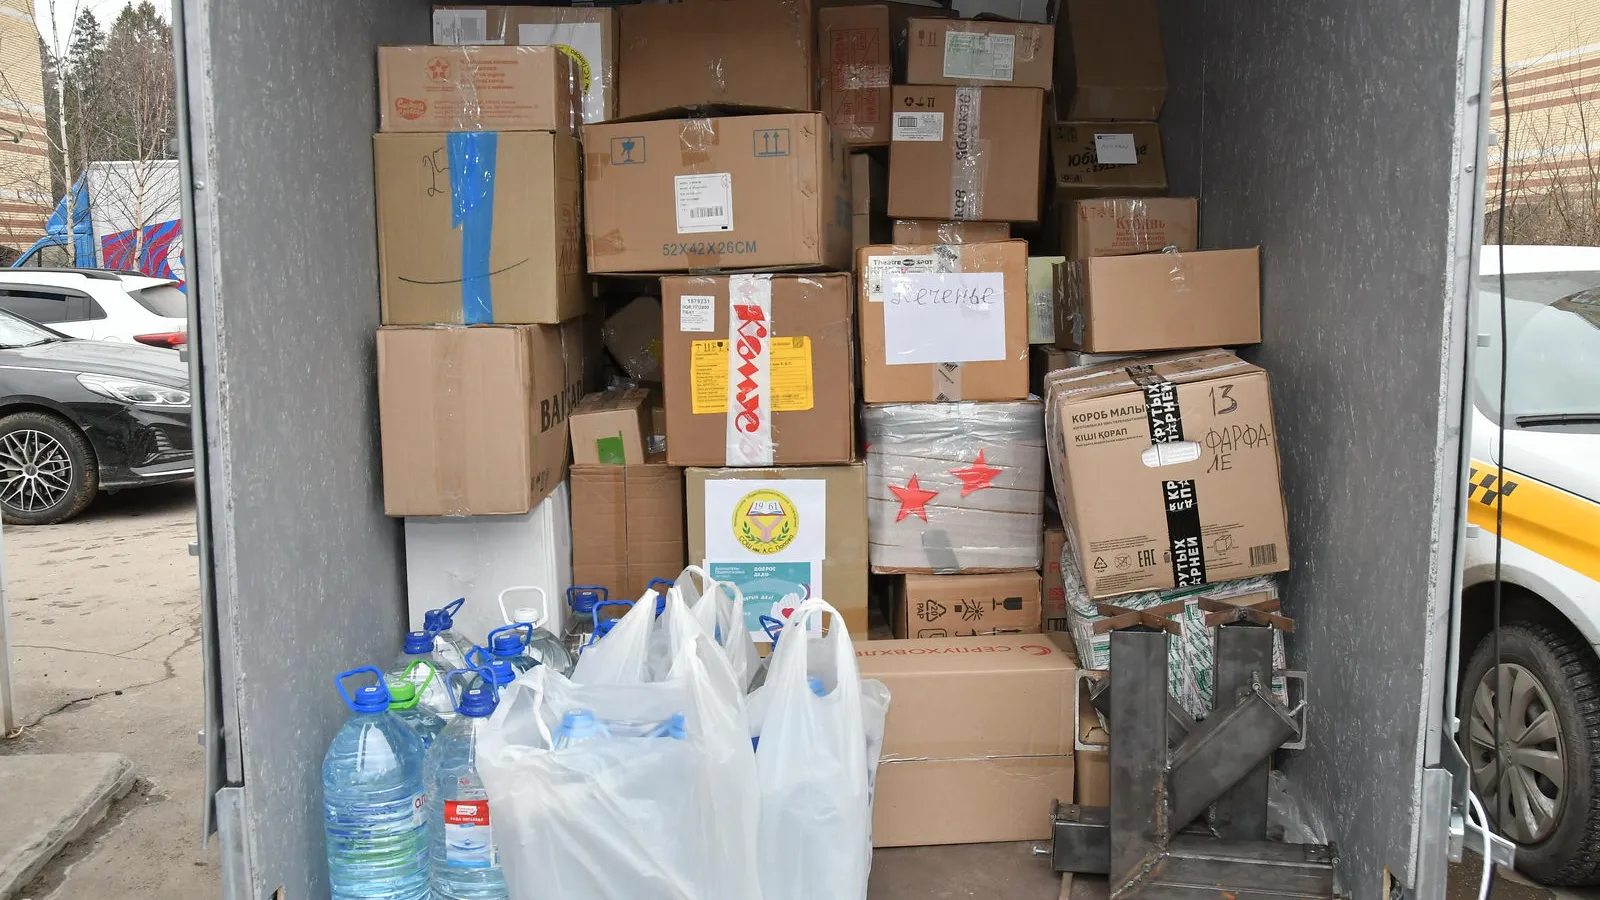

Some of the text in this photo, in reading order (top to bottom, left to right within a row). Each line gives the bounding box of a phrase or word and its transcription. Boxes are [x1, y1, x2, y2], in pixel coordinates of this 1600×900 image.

[1208, 384, 1238, 417] 13
[1071, 403, 1146, 424] КОРОБ МАЛЫ
[1147, 384, 1167, 444] КРУТЫХ
[754, 502, 778, 510] 19 61
[916, 602, 924, 620] PAP
[932, 605, 939, 617] 20
